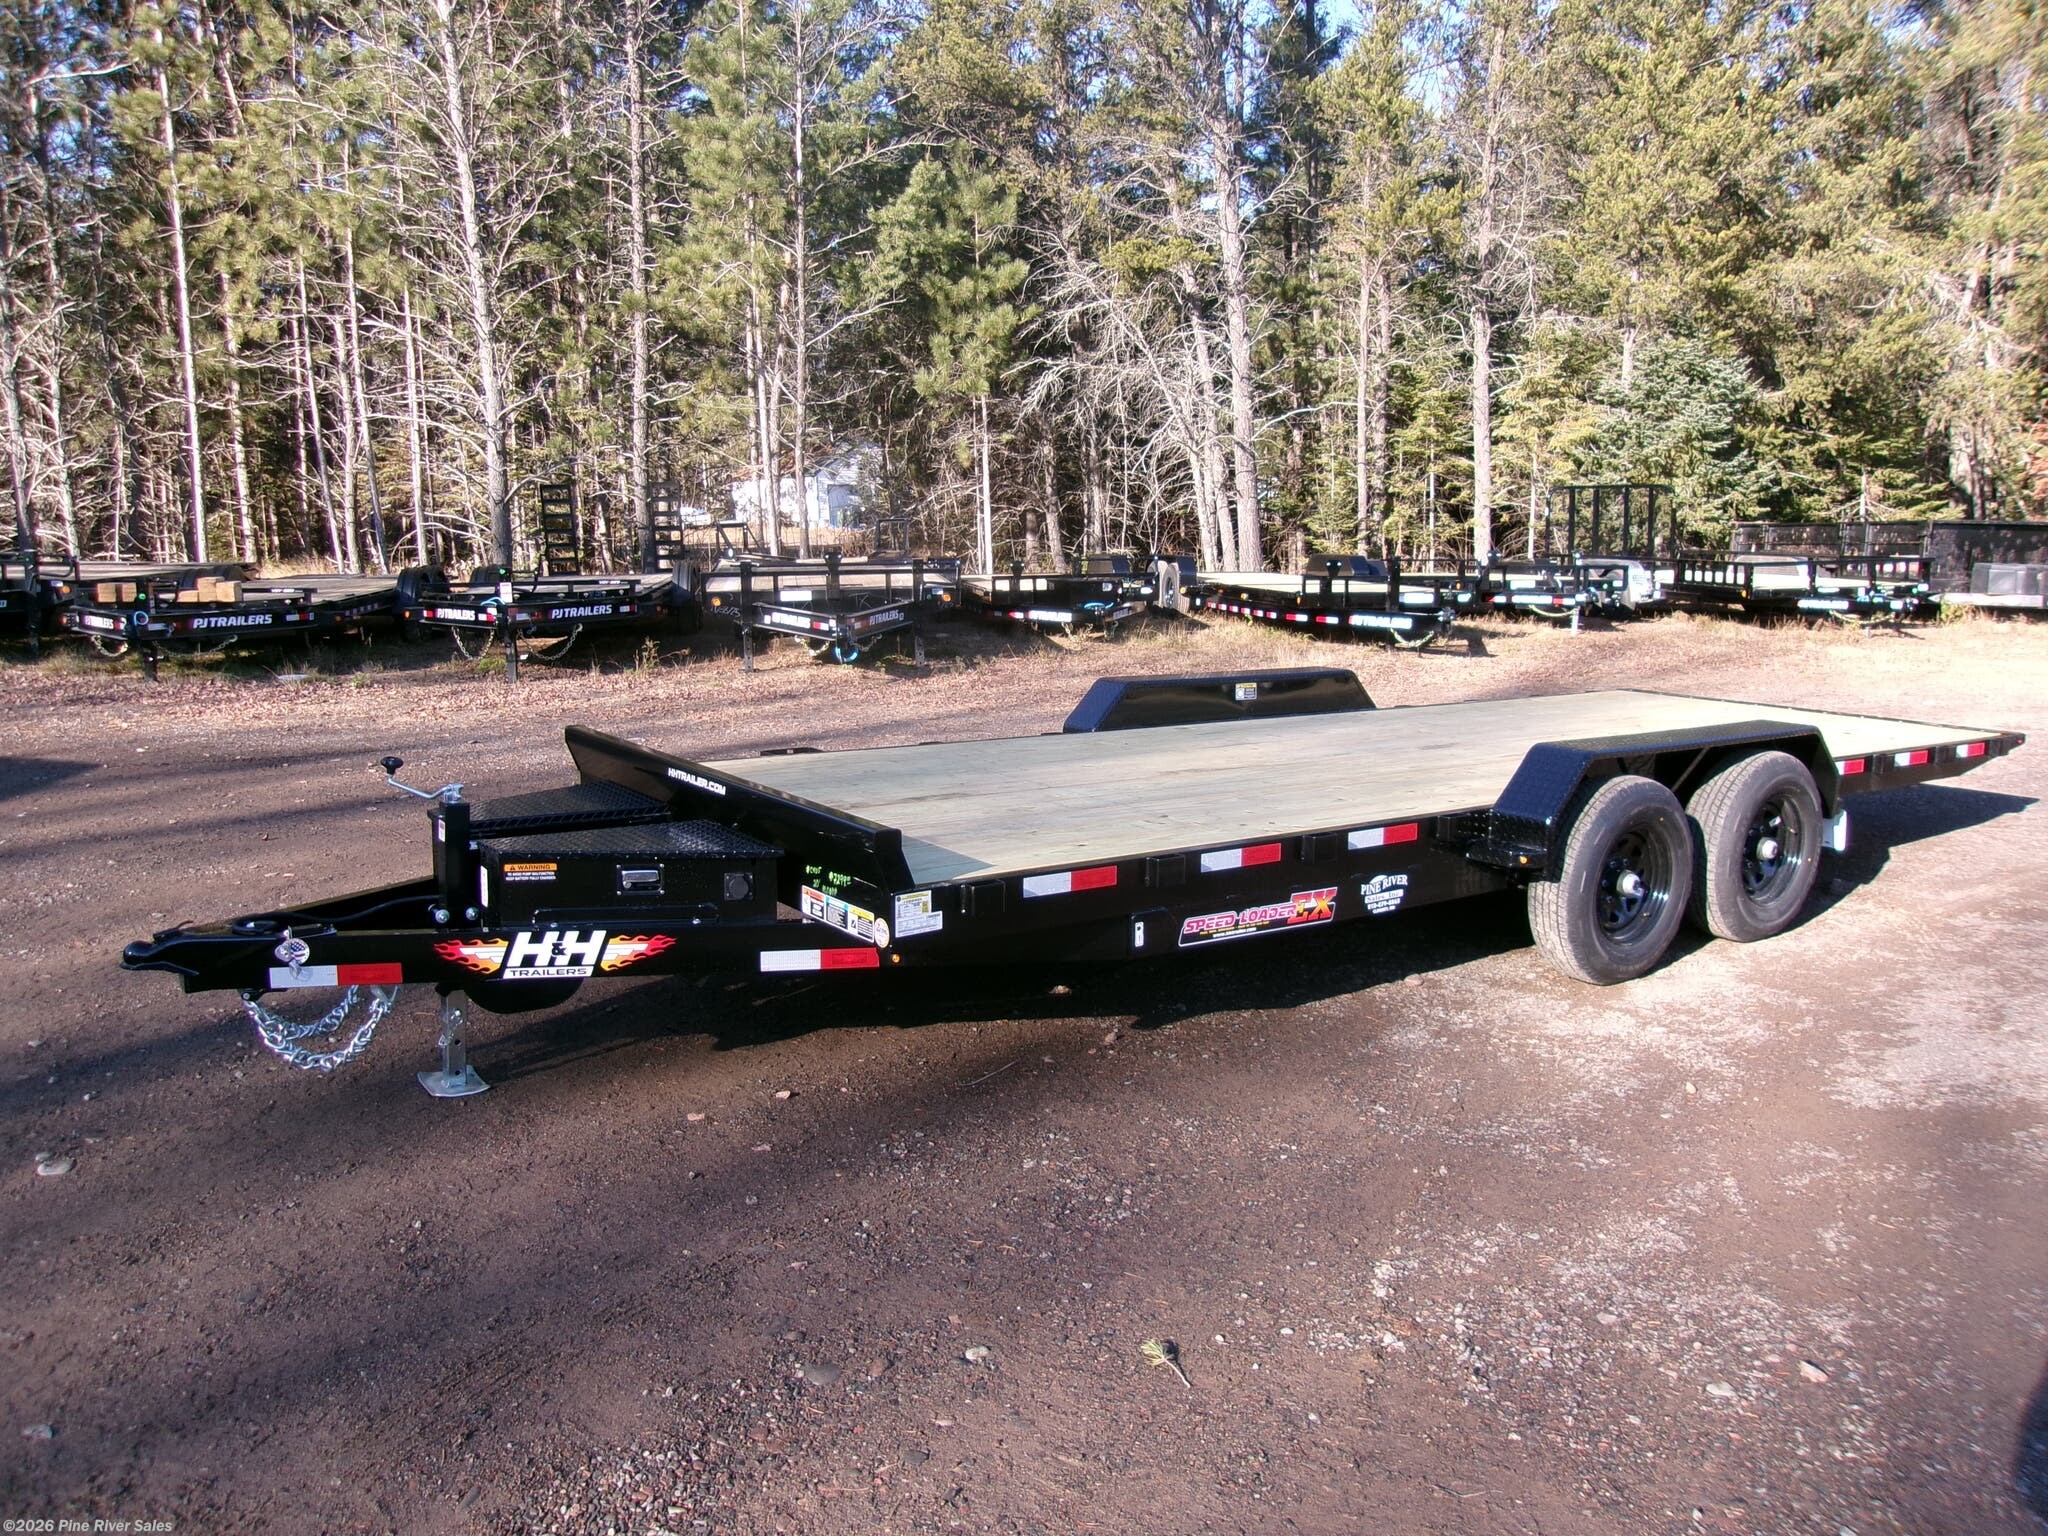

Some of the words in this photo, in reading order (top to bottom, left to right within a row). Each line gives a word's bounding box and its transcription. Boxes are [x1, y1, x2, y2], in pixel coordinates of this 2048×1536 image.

[1360, 881, 1382, 895] PINE
[1382, 874, 1408, 889] RIVER
[1287, 888, 1338, 925] EX
[506, 930, 607, 967] H&H
[509, 967, 588, 977] TRAILERS
